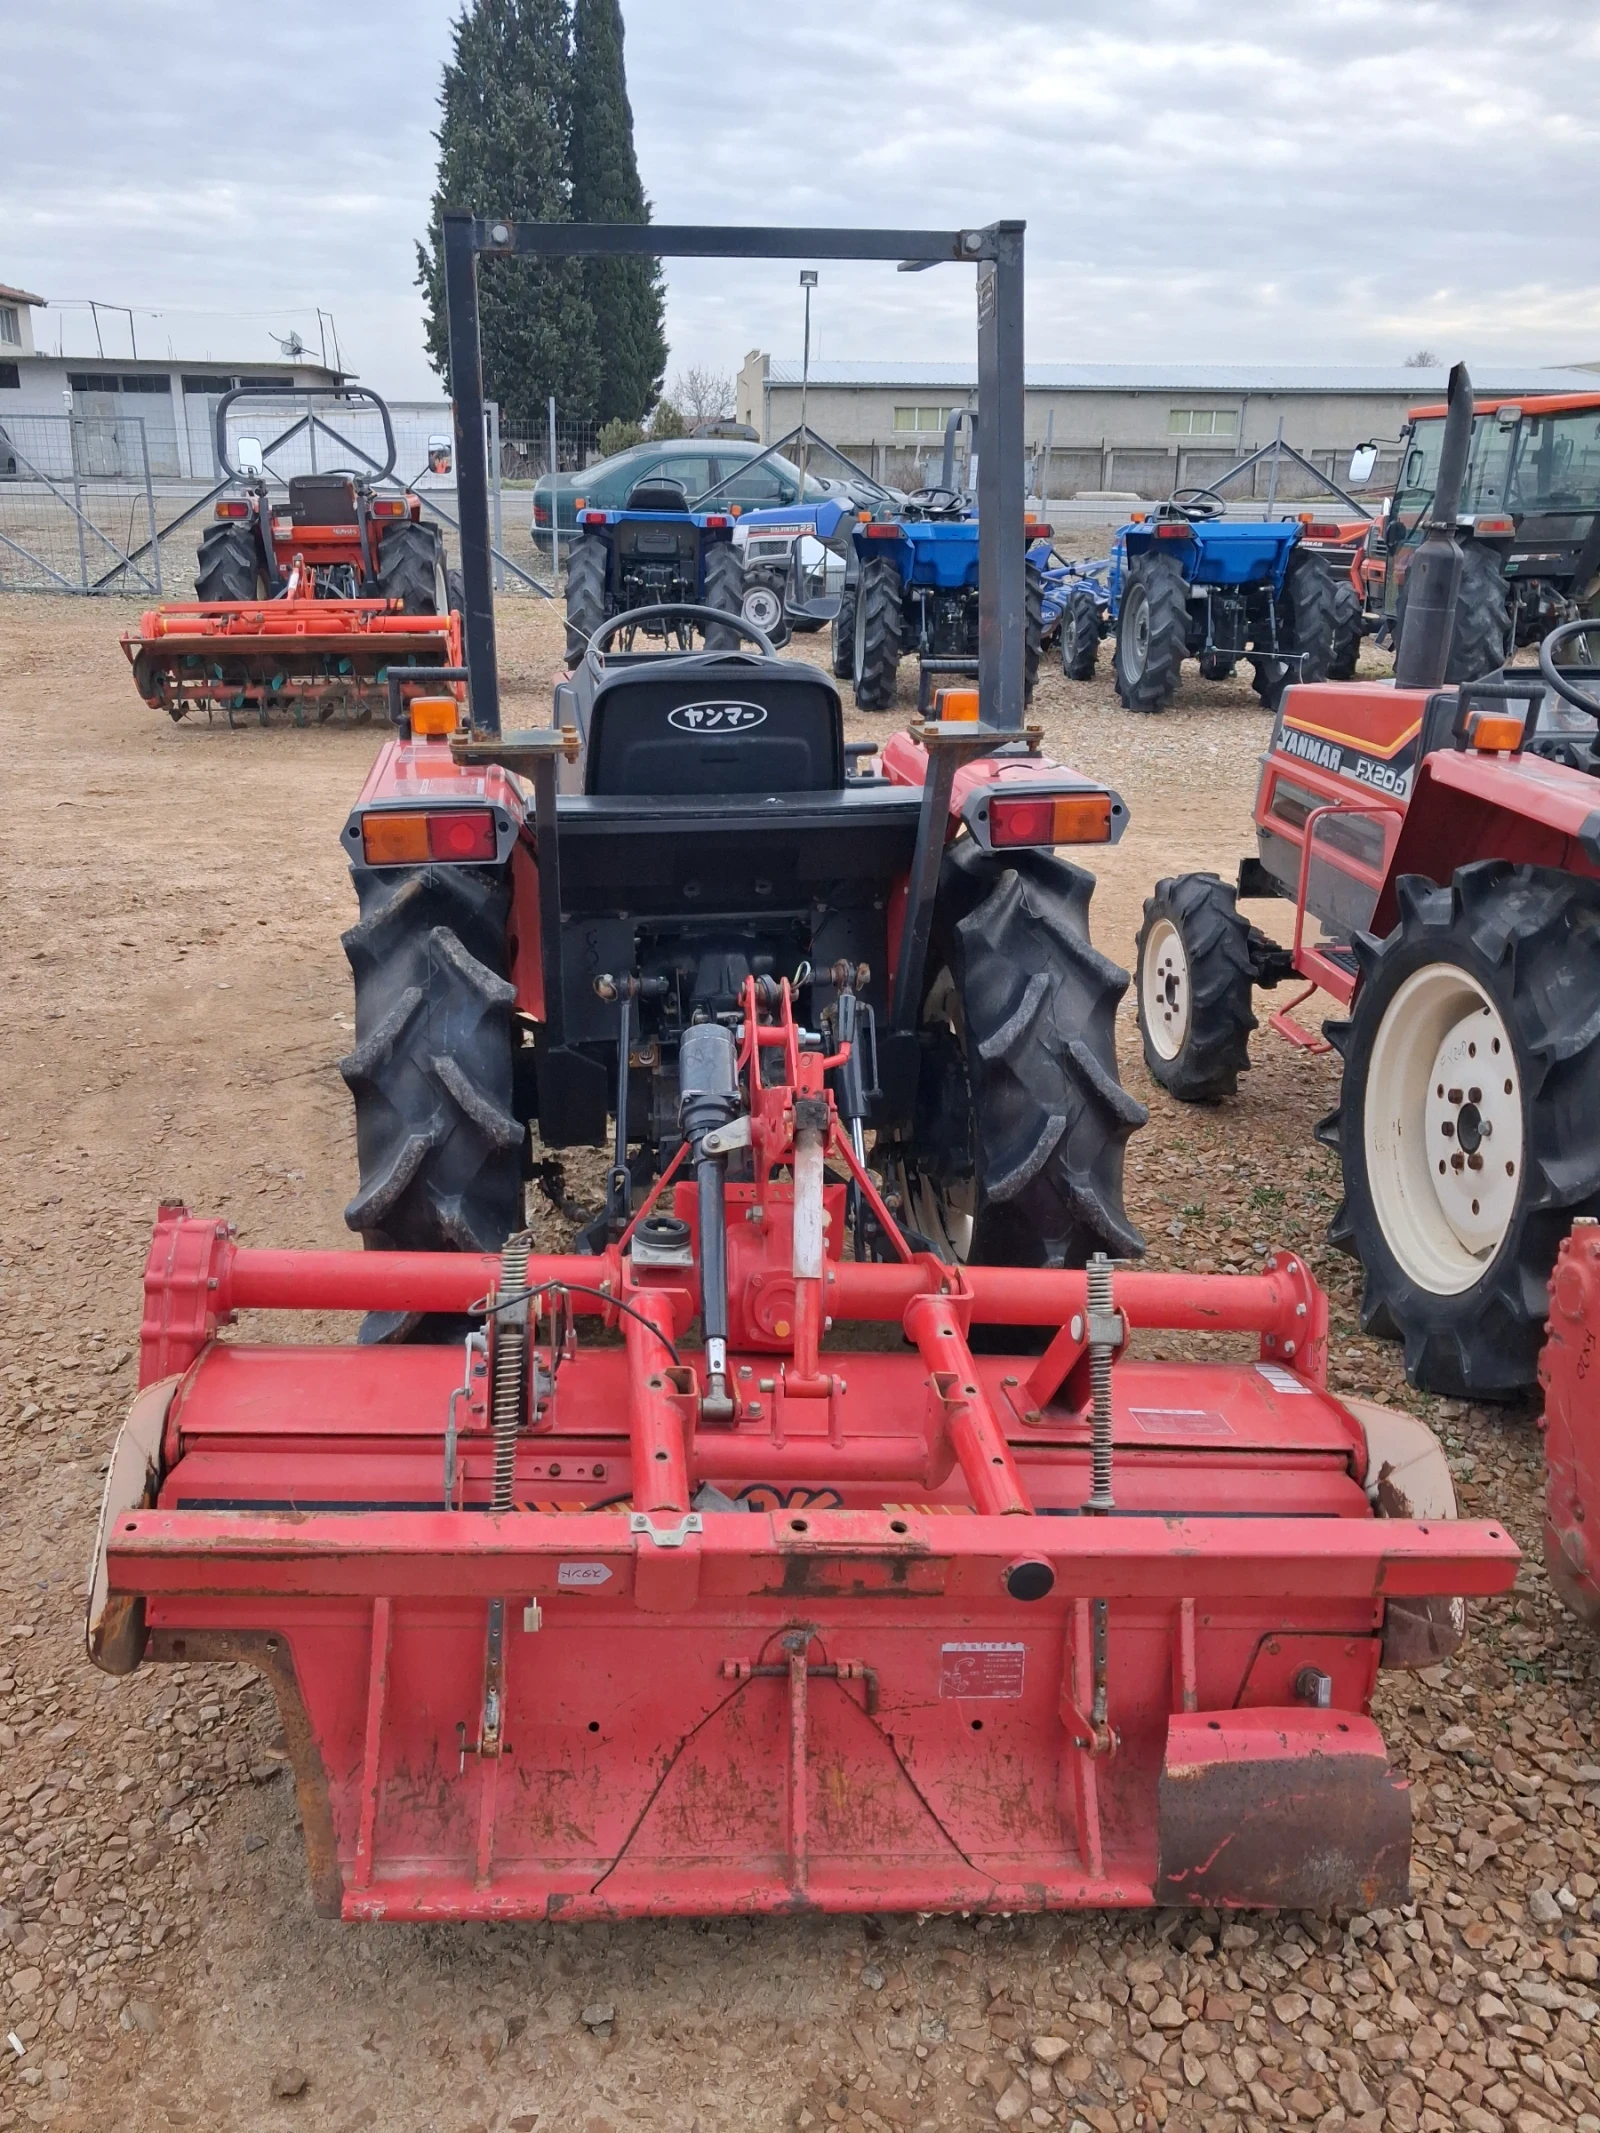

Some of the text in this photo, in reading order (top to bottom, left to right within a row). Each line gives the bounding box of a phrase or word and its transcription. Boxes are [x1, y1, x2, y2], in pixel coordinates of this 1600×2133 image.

[800, 524, 813, 532] 22
[684, 707, 755, 727] ヤンマー
[1281, 728, 1405, 795] YANMAR FX20D
[561, 1569, 602, 1578] スタンド
